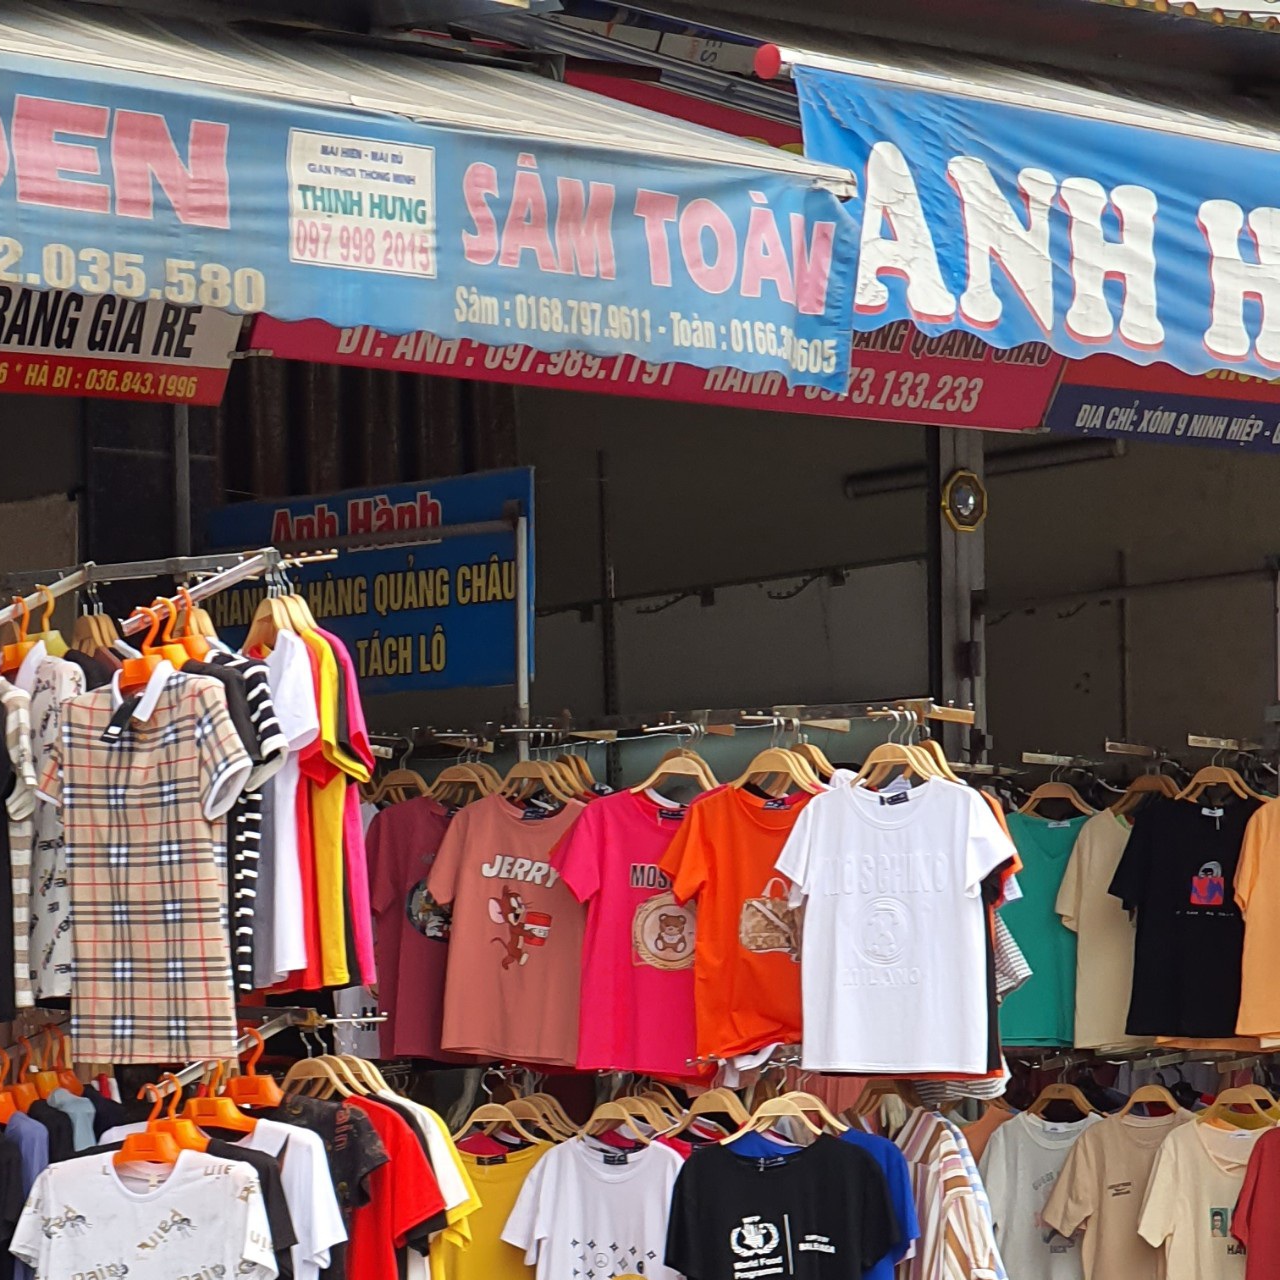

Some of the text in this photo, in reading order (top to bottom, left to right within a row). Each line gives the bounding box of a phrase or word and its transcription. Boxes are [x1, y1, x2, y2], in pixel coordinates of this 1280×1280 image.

[298, 184, 363, 218] THỊNH
[462, 153, 616, 281] SÂM
[296, 219, 430, 271] 097 998 2015
[855, 141, 1165, 352] ANH
[454, 286, 500, 326] Sâm
[515, 294, 651, 342] 0168.797.9611
[670, 312, 717, 349] Toàn
[52, 365, 73, 389] BI
[85, 368, 198, 398] 036.843.1996
[1076, 404, 1106, 433] ĐỊA
[1137, 405, 1176, 434] XÓM
[1175, 413, 1189, 436] 9
[1187, 414, 1228, 439] NINH
[1226, 413, 1264, 446] HIỆP
[374, 553, 449, 616] QUẢNG
[456, 555, 516, 605] CHÂU
[356, 624, 448, 678] TÁCH LÔ
[482, 855, 560, 888] JERRY
[631, 863, 671, 889] MOS
